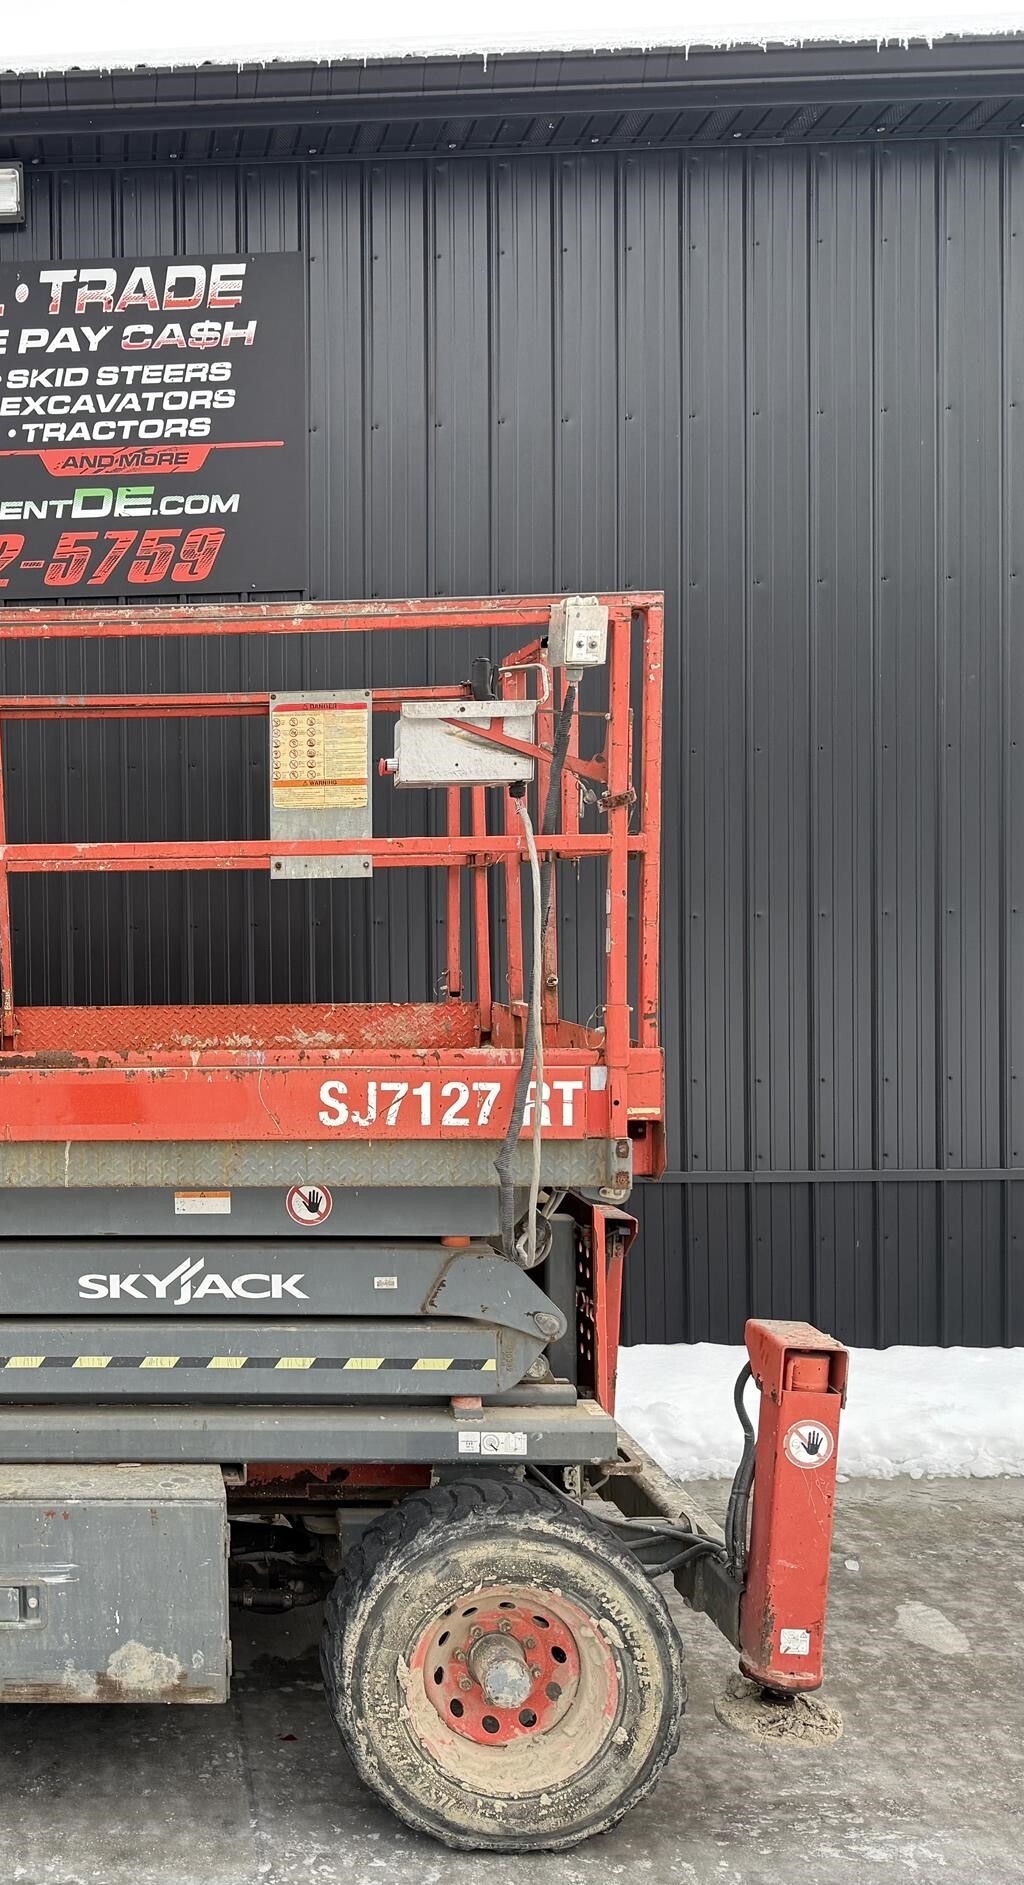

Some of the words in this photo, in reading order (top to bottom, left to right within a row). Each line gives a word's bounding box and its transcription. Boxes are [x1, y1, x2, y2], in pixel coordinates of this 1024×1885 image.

[38, 262, 248, 314] TRADE
[17, 325, 114, 354] PAY
[120, 319, 258, 350] CA$H
[6, 366, 89, 389] SKID
[95, 361, 233, 387] STEERS
[0, 388, 237, 417] EXCAVATORS
[21, 416, 212, 443] TRACTORS
[61, 455, 118, 470] AND
[118, 451, 190, 468] MORE
[318, 1080, 501, 1127] SJ7127
[77, 1256, 311, 1306] SKYJACK
